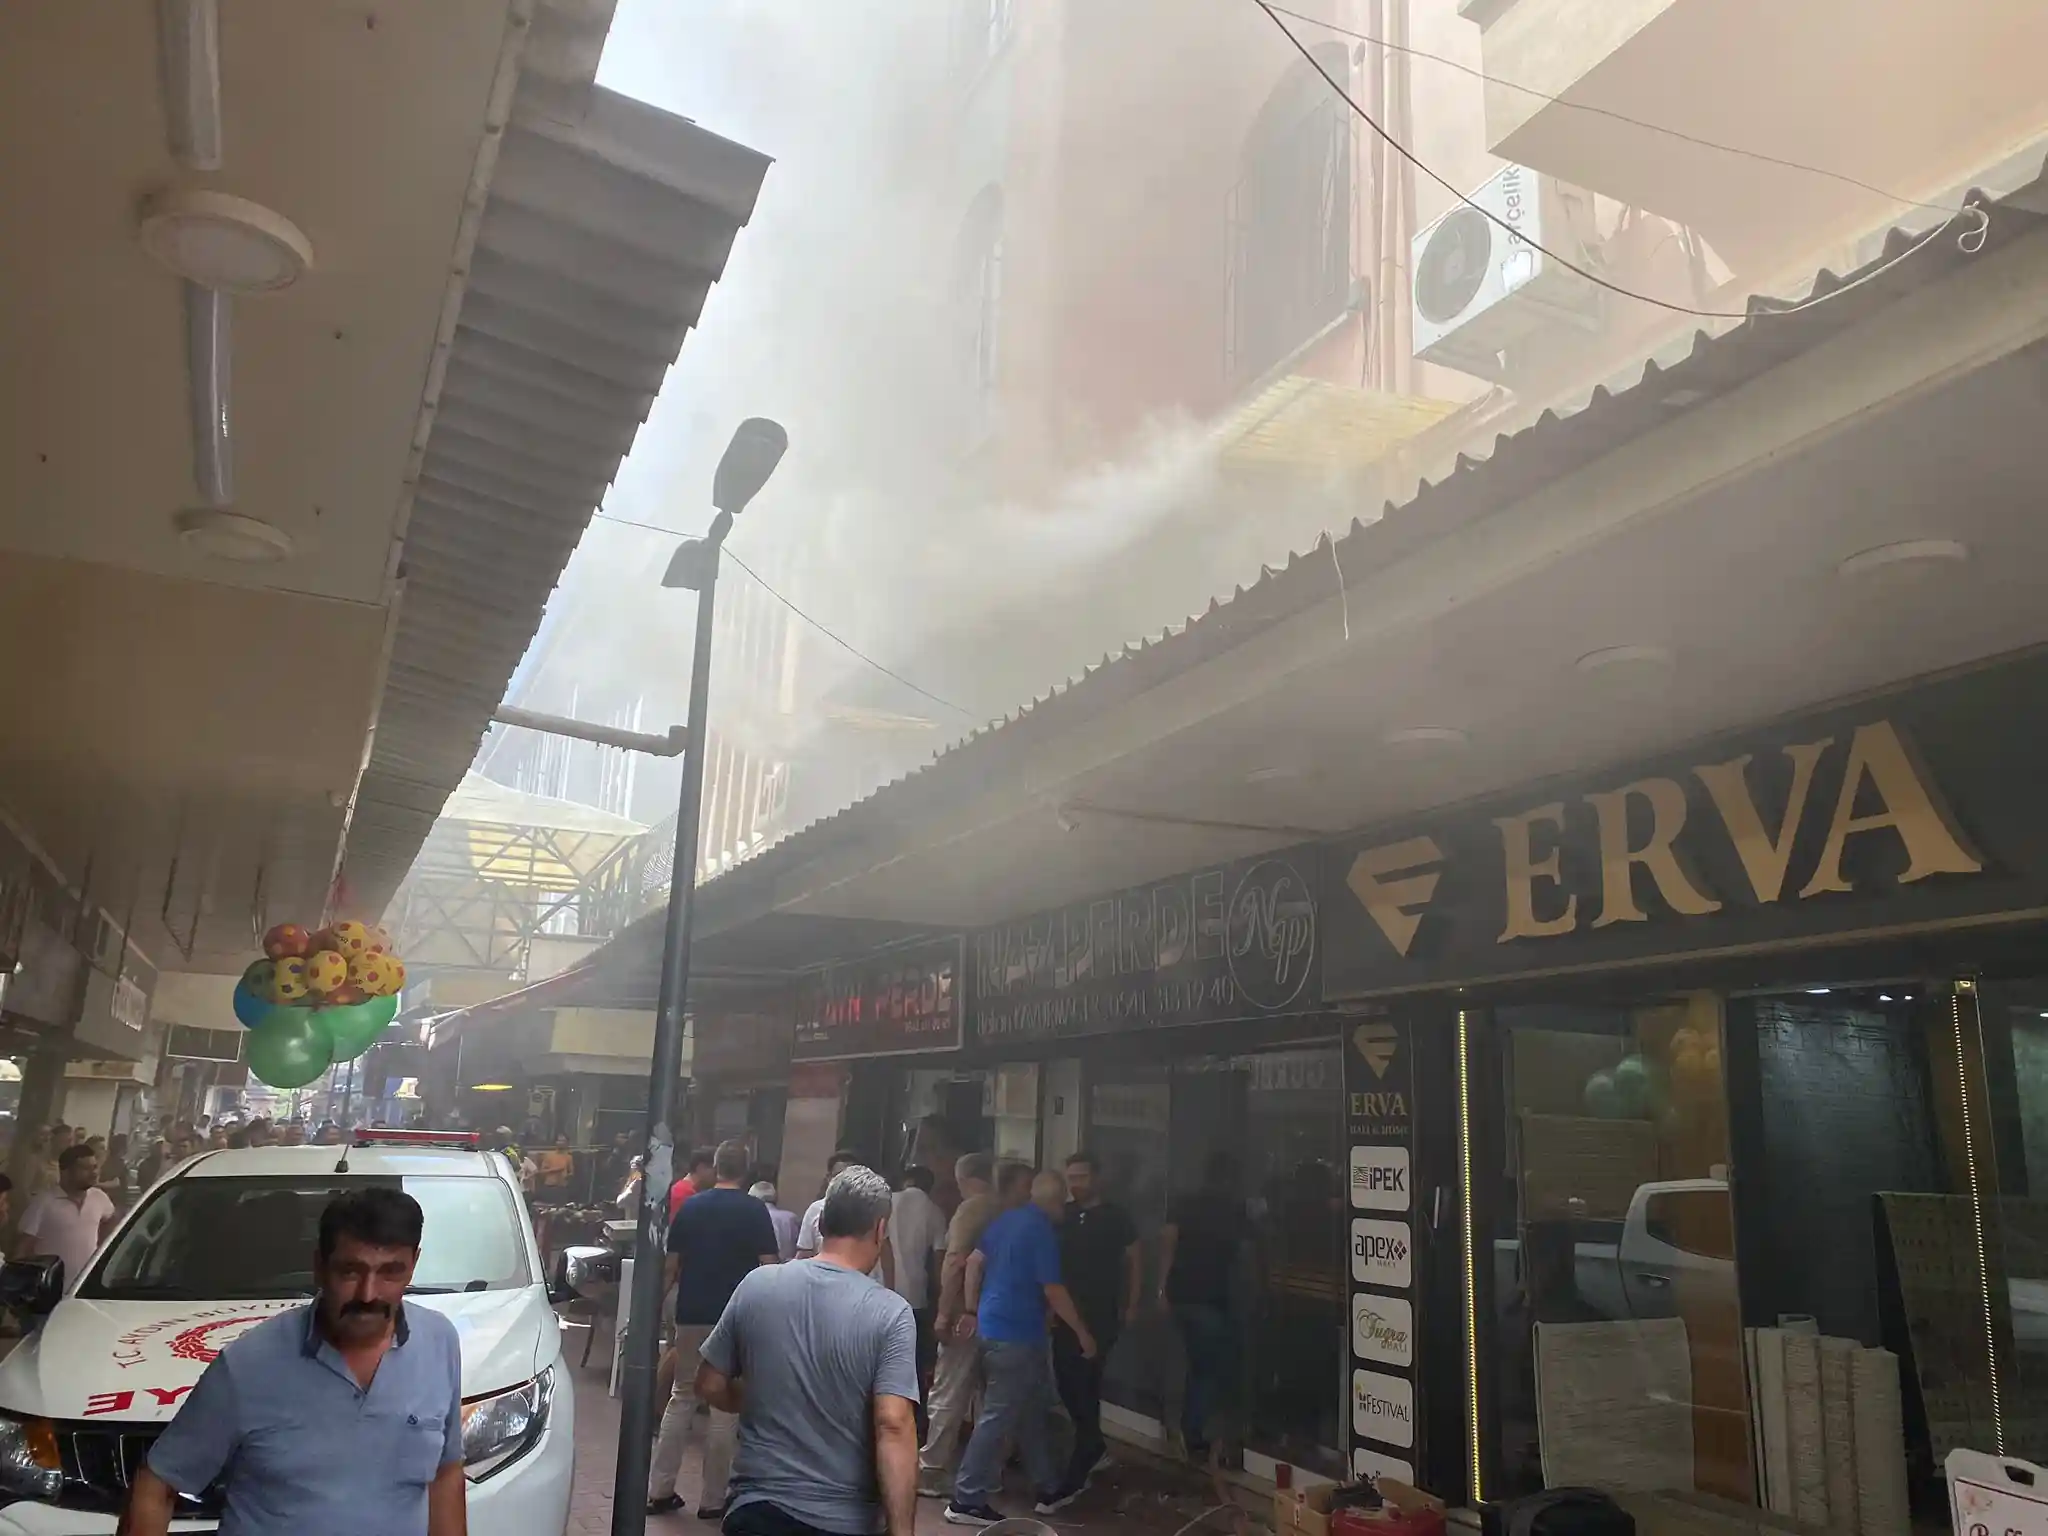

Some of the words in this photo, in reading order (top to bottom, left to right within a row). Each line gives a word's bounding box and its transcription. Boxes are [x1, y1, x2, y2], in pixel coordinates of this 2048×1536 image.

[1502, 167, 1526, 246] arçelik
[1493, 719, 1983, 945] ERVA
[1062, 870, 1224, 983] PERDE
[1207, 974, 1235, 1007] 40
[1350, 1091, 1409, 1117] ERVA
[1355, 1234, 1395, 1268] apex
[117, 1315, 193, 1346] AYDIN
